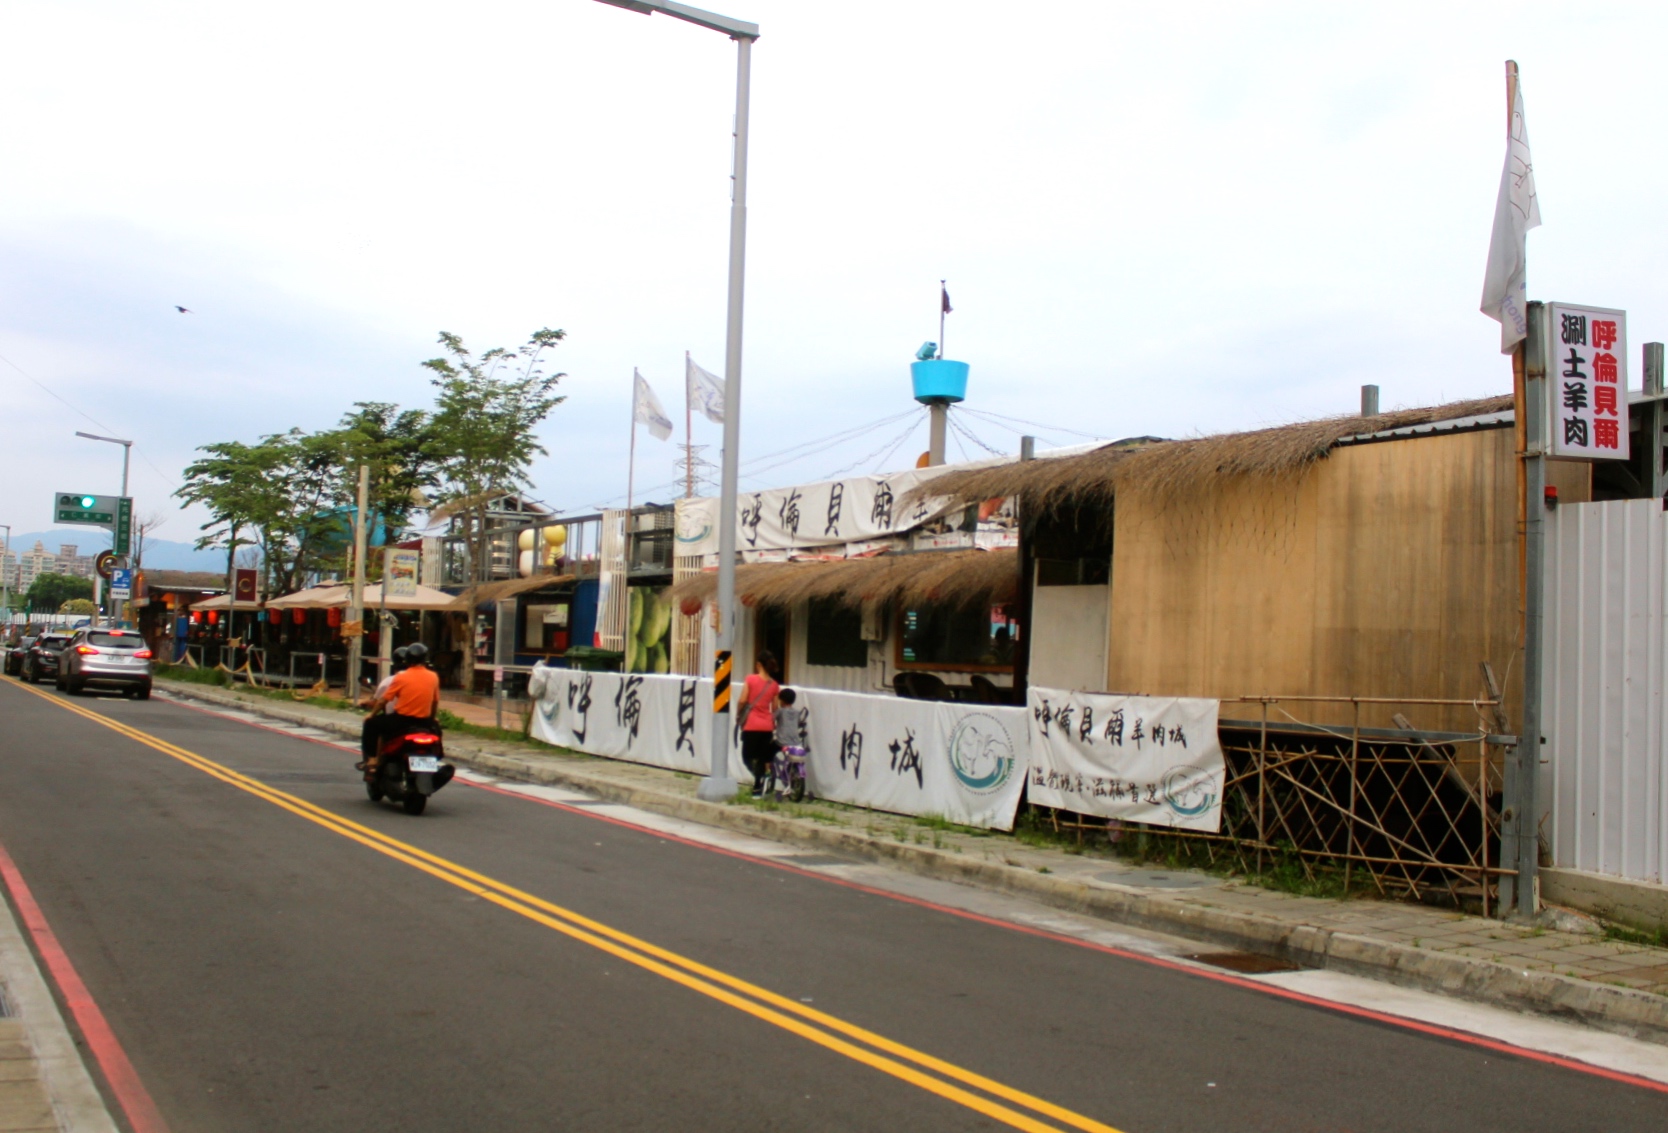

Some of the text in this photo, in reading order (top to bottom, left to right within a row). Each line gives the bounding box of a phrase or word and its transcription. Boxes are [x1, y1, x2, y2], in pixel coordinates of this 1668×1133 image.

[1561, 313, 1588, 447] 涮土羊肉
[1591, 320, 1619, 449] 呼倫貝爾
[113, 570, 124, 582] P
